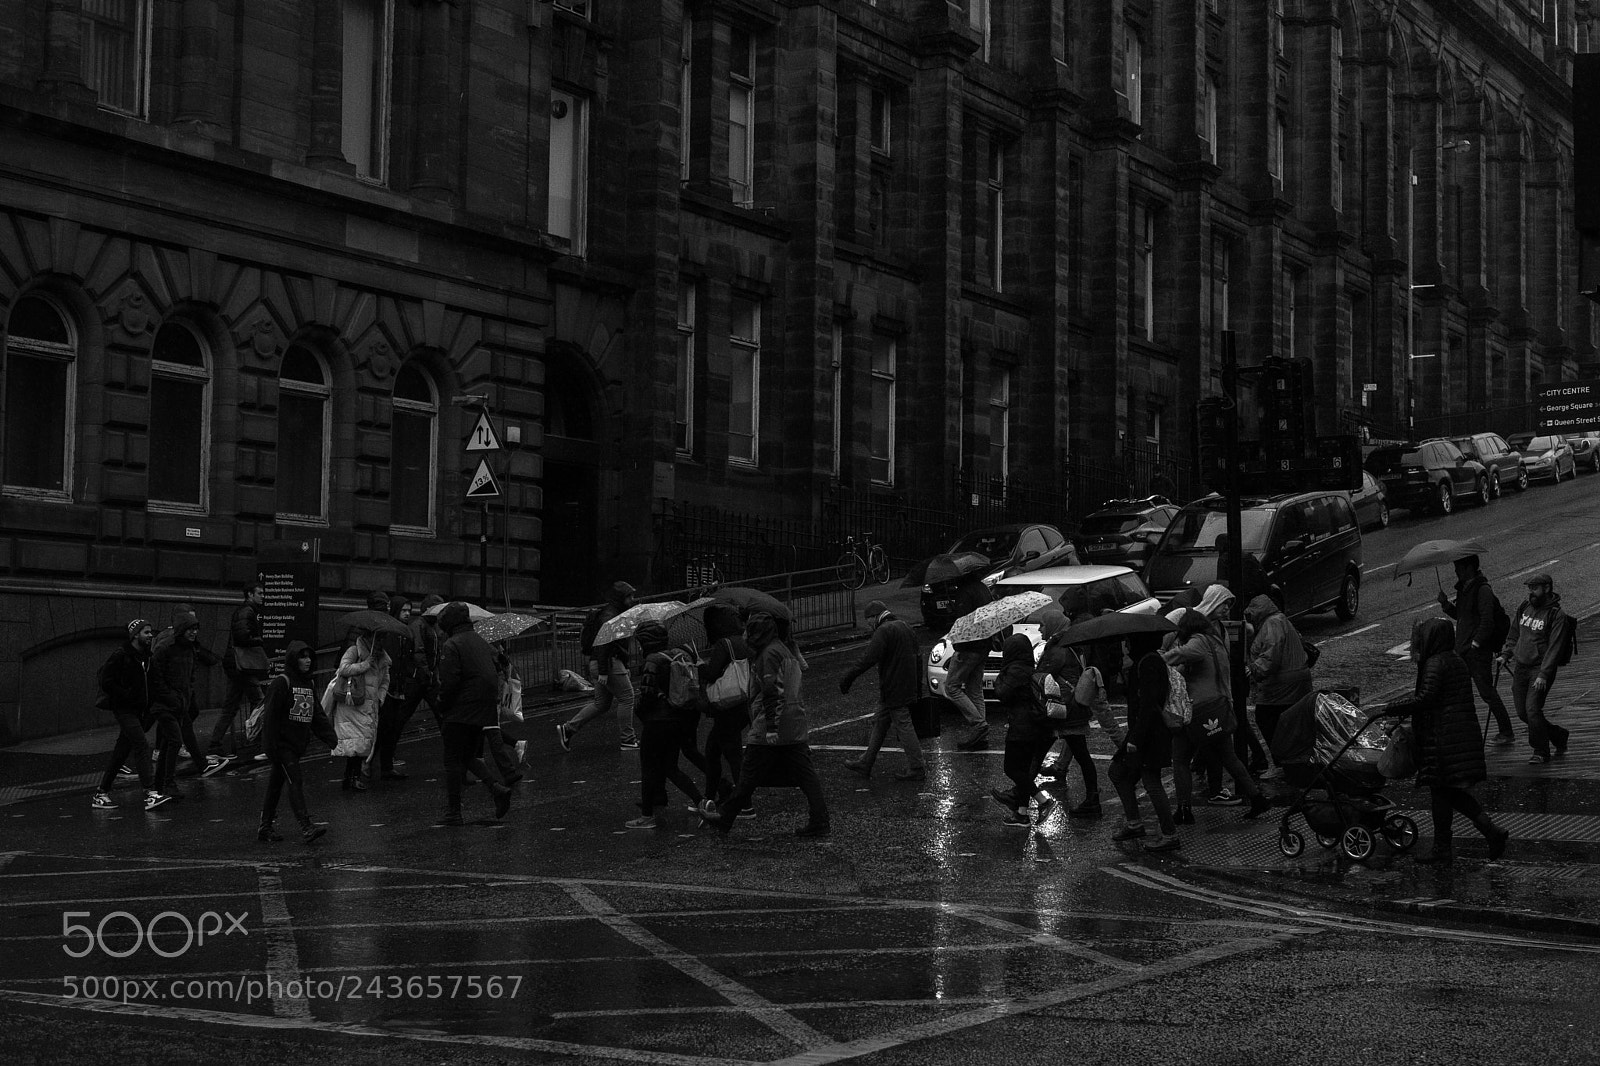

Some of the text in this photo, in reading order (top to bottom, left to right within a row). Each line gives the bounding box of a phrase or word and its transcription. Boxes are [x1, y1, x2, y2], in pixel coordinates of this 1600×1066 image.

[1546, 386, 1591, 397] CITY CENTRE
[1546, 404, 1570, 412] George
[1570, 402, 1594, 410] Square
[1575, 416, 1597, 425] Street
[474, 473, 490, 487] 13%
